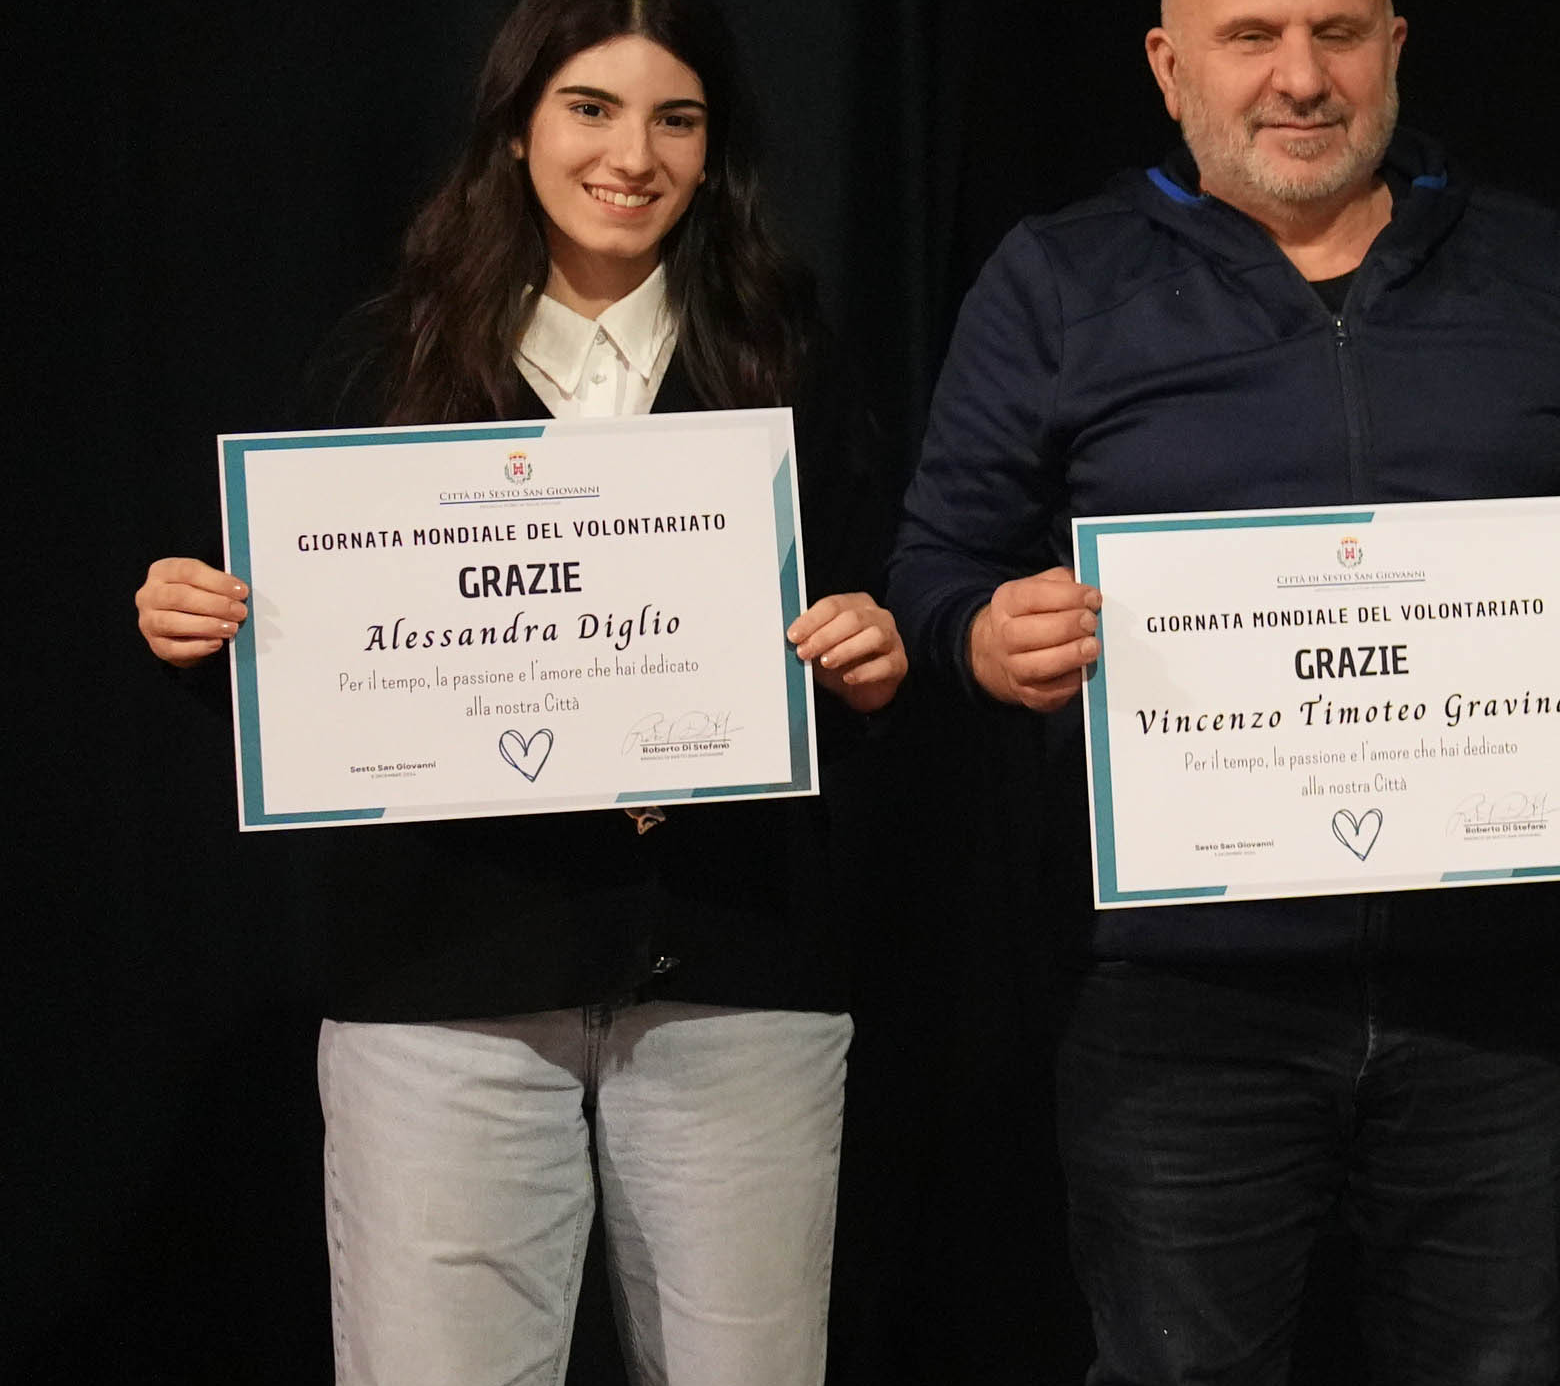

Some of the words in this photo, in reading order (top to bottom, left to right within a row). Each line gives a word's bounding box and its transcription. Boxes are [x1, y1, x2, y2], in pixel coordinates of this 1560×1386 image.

[297, 530, 403, 552] GIORNATA
[413, 524, 517, 546] MONDIALE
[526, 522, 564, 541] DEL
[572, 513, 726, 538] VOLONTARIATO
[458, 561, 583, 599] GRAZIE
[364, 611, 559, 652] Alessandra
[577, 604, 680, 651] Diglio
[1146, 612, 1243, 634] GIORNATA
[1252, 607, 1349, 629] MONDIALE
[1357, 606, 1392, 623] DEL
[1400, 598, 1544, 621] VOLONTARIATO
[339, 672, 364, 692] Per
[368, 669, 377, 691] il
[381, 677, 431, 692] tempo,
[435, 665, 449, 687] la
[452, 670, 514, 690] passione
[518, 671, 527, 683] e
[530, 659, 583, 681] l'amore
[587, 656, 611, 678] che
[615, 655, 636, 677] hai
[640, 652, 699, 676] dedicato
[1294, 644, 1410, 681] GRAZIE
[465, 694, 492, 717] alla
[495, 700, 540, 715] nostra
[544, 692, 580, 712] Città
[1135, 709, 1282, 735] Vincenzo
[1299, 693, 1427, 726] Timoteo
[1184, 751, 1208, 771] Per
[1211, 749, 1219, 771] il
[1223, 756, 1269, 774] tempo,
[1273, 745, 1285, 766] la
[1289, 750, 1346, 772] passione
[1350, 752, 1358, 762] e
[1361, 740, 1410, 762] l'amore
[1413, 738, 1436, 759] che
[1440, 737, 1460, 758] hai
[1463, 734, 1518, 757] dedicato
[1301, 775, 1325, 797] alla
[1328, 780, 1371, 795] nostra
[1374, 772, 1407, 793] Città
